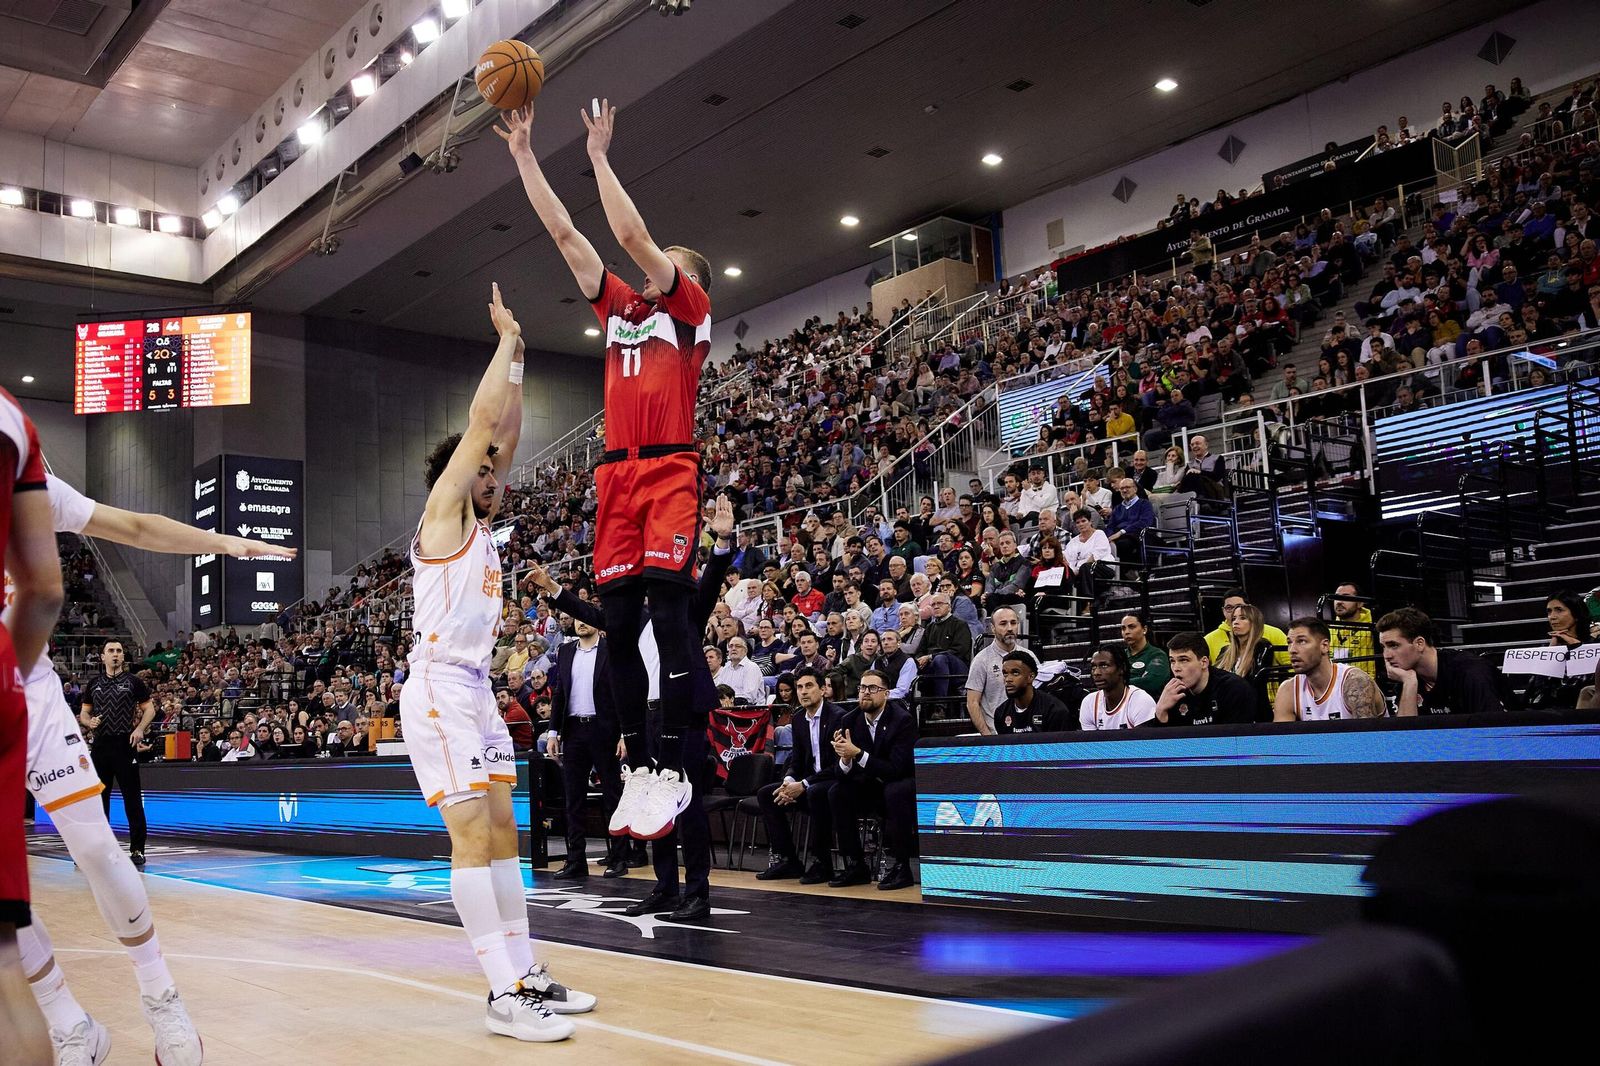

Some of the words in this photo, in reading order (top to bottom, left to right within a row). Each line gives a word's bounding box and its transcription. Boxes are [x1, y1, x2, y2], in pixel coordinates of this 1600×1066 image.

[1166, 226, 1230, 253] AYUNTIENTO
[1232, 221, 1245, 230] DE
[1246, 206, 1291, 225] GRANADA
[165, 322, 180, 331] 44
[153, 349, 170, 359] 2Q
[621, 347, 641, 377] 11
[148, 390, 156, 401] 5
[167, 389, 175, 399] 3
[251, 476, 293, 486] AYUNTAMIENTO
[263, 483, 290, 493] GRANADA
[247, 504, 291, 515] emasagra
[1506, 650, 1566, 662] RESPETO
[28, 764, 75, 791] Midea
